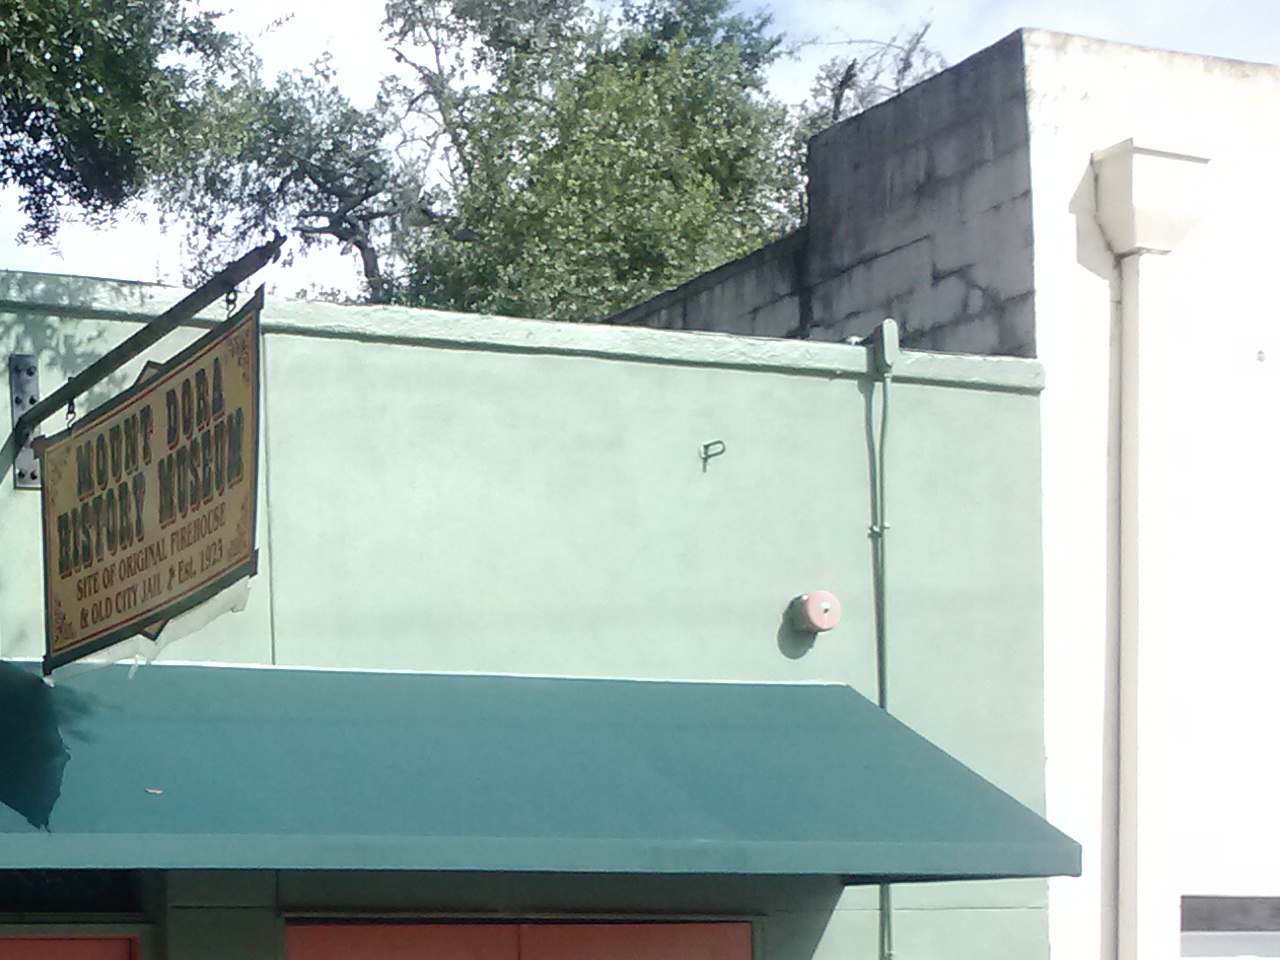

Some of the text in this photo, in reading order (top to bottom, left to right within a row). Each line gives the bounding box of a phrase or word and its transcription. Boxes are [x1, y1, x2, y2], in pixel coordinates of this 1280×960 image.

[76, 356, 226, 502] MOUNT DORA
[57, 407, 245, 579] HISTORY MUSEUM
[76, 502, 226, 600] SITE OF ORIGINAL FIREHOUSE
[80, 607, 89, 629] &
[91, 596, 114, 625] OLD
[115, 583, 138, 614] CITY
[141, 573, 162, 602] JAIL
[178, 555, 197, 584] Est.
